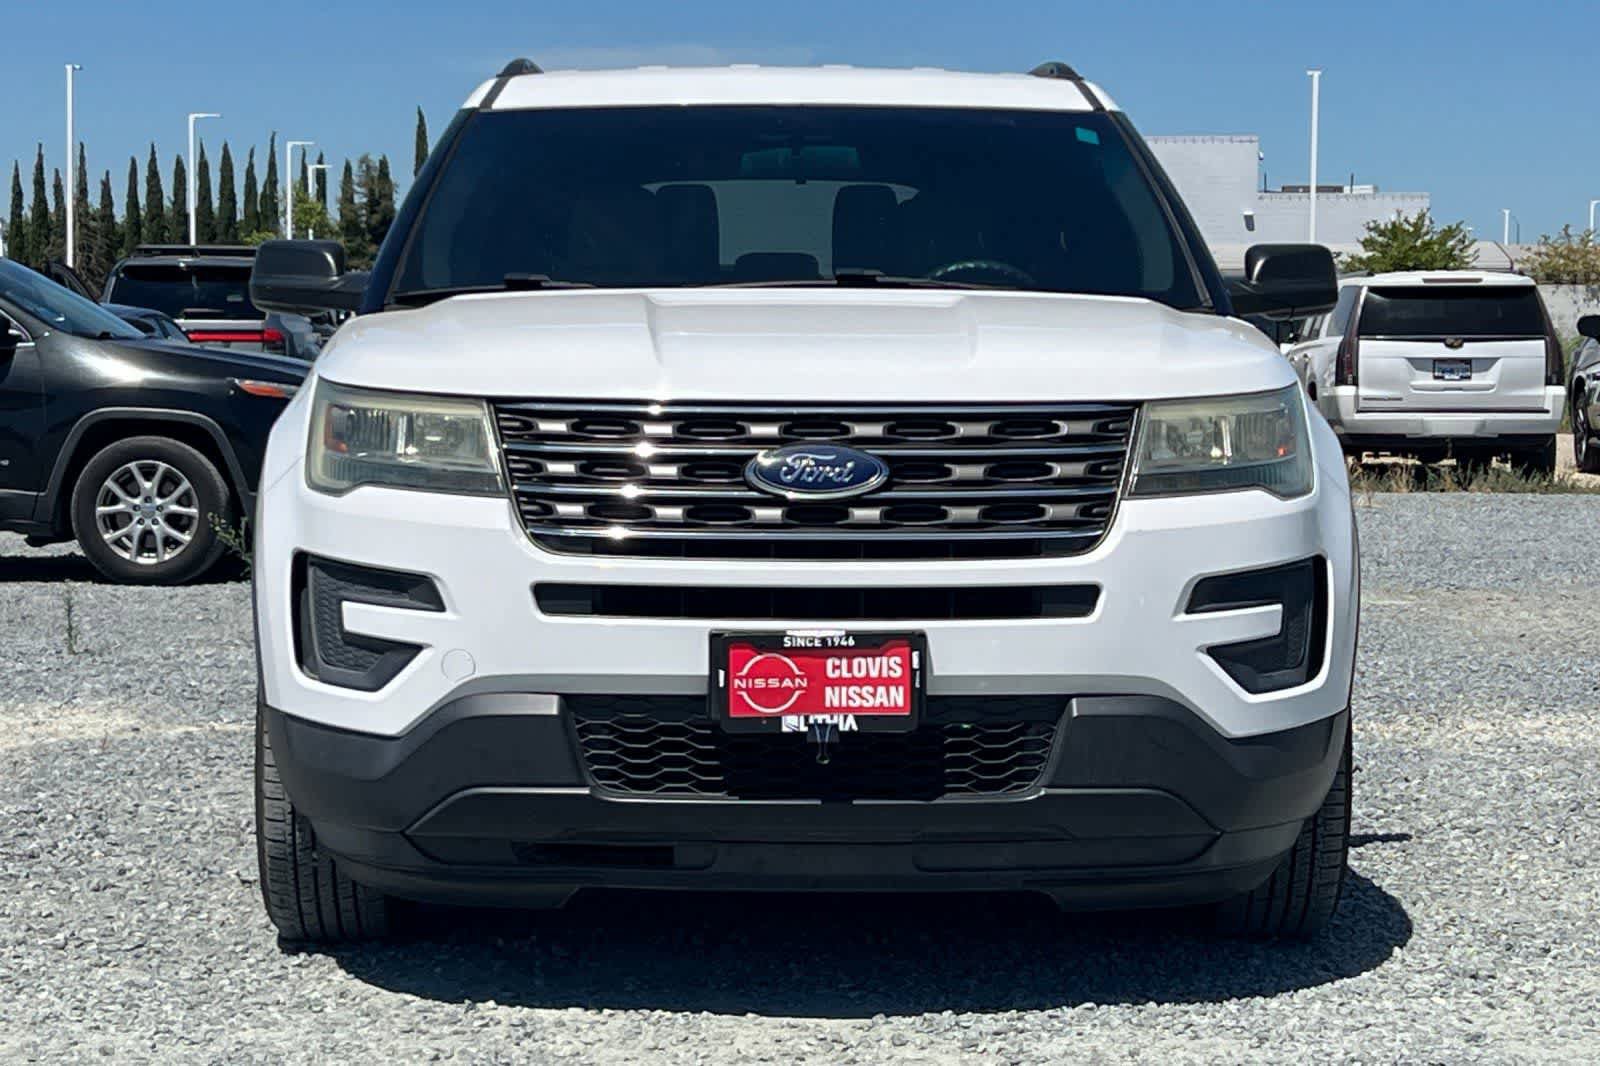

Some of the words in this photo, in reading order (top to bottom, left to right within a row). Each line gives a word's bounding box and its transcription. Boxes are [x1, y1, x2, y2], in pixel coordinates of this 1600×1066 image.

[779, 453, 855, 483] Ford
[783, 636, 822, 647] SINCE
[825, 636, 856, 647] 1946
[825, 656, 904, 679] CLOVIS
[733, 677, 808, 689] NISSAN
[824, 685, 905, 708] NISSAN
